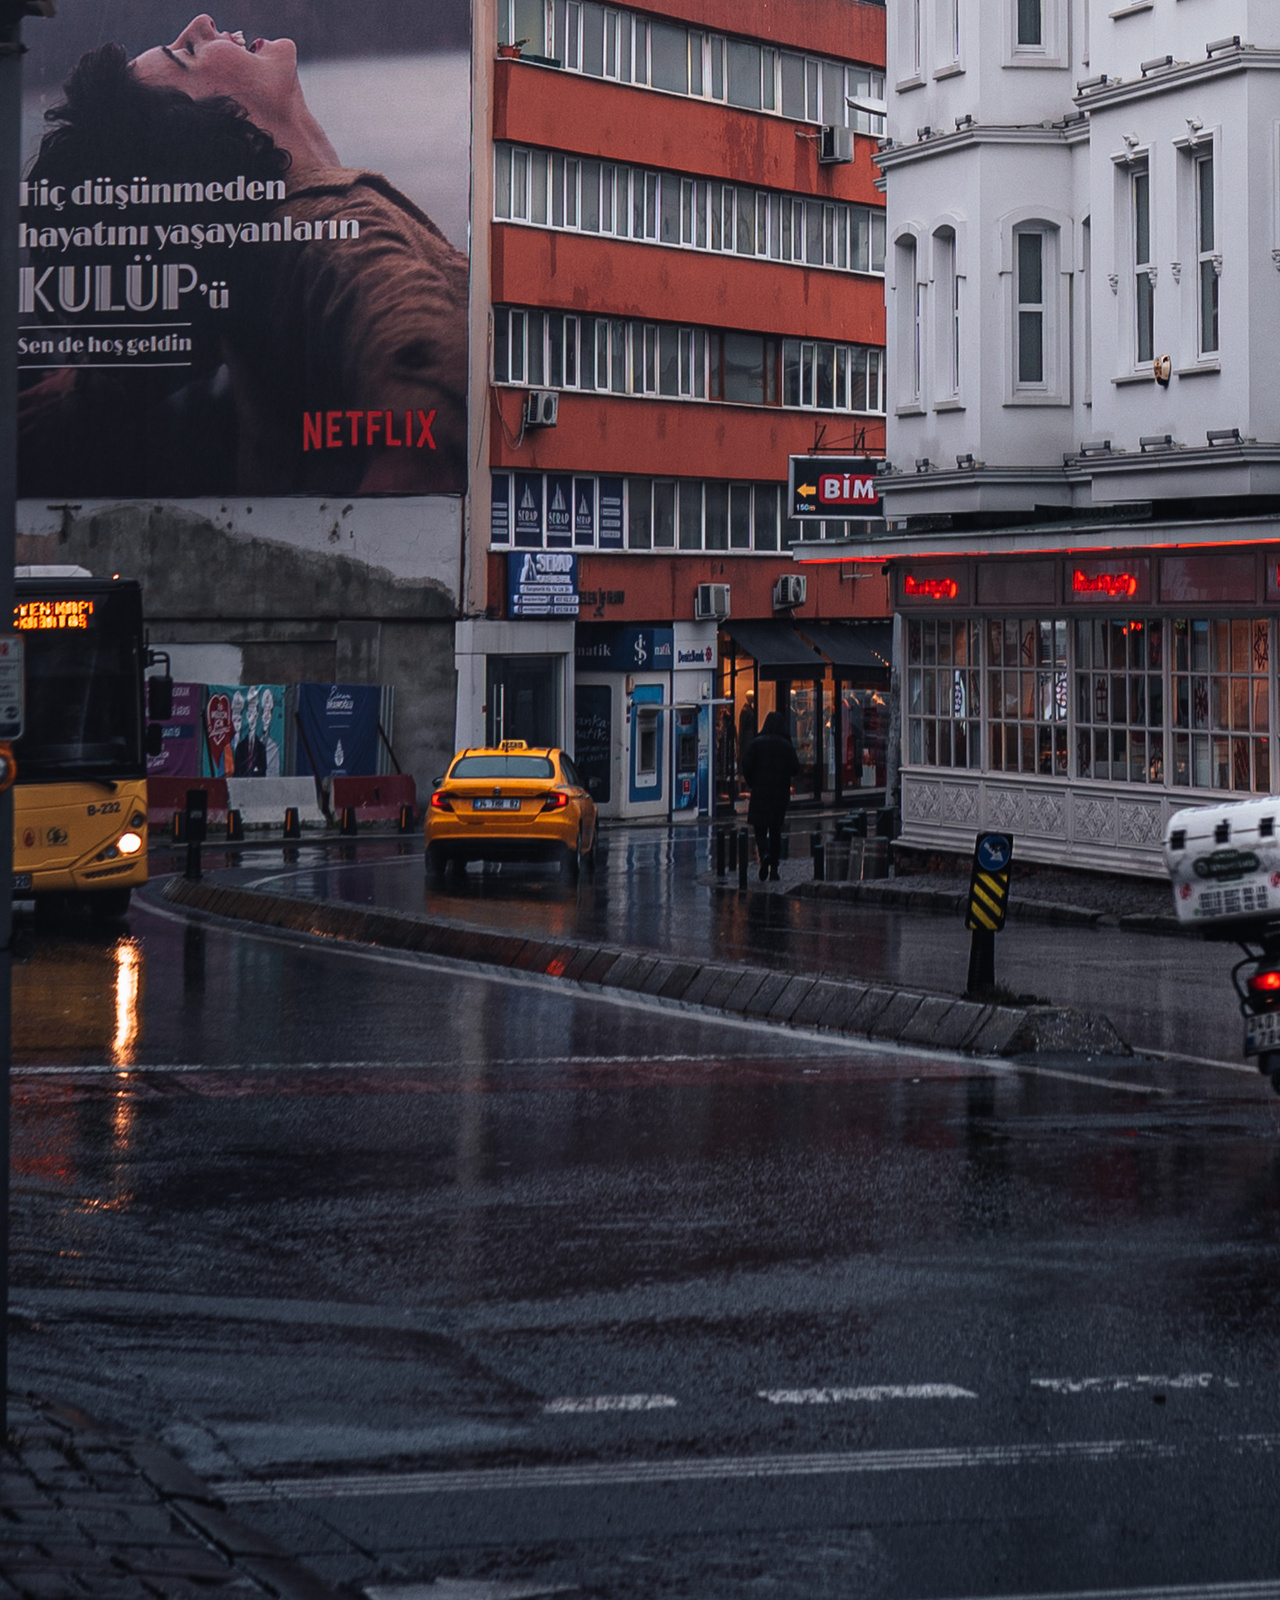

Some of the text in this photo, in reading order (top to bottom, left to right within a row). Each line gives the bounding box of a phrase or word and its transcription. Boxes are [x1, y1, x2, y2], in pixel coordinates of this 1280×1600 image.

[19, 176, 286, 211] Hiç düşünmeden
[18, 216, 359, 252] hayatını yaşayanların
[17, 334, 192, 356] Sen de hoş geldin
[303, 410, 436, 451] NETFLIX
[824, 473, 875, 499] BİM
[87, 801, 121, 816] B-232
